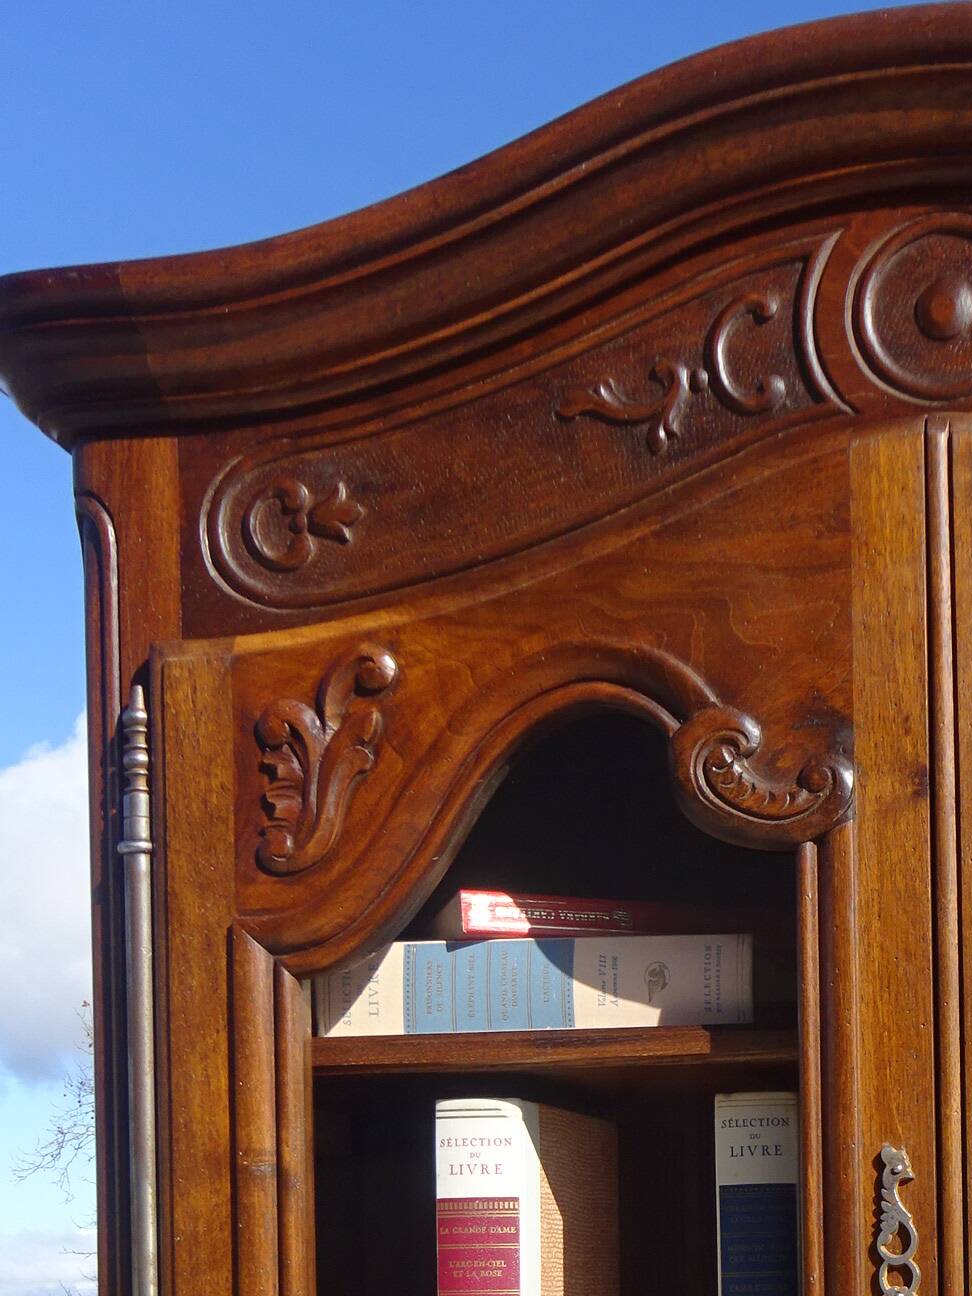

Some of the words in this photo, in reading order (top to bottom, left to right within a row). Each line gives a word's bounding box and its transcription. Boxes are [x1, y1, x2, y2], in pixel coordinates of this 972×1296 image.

[721, 1117, 791, 1129] SÉLECTION
[440, 1137, 513, 1148] SÉLECTION
[730, 1144, 783, 1157] LIVRE
[449, 1164, 503, 1175] LIVRE
[490, 1226, 517, 1234] DAME
[480, 1269, 503, 1277] ROSE
